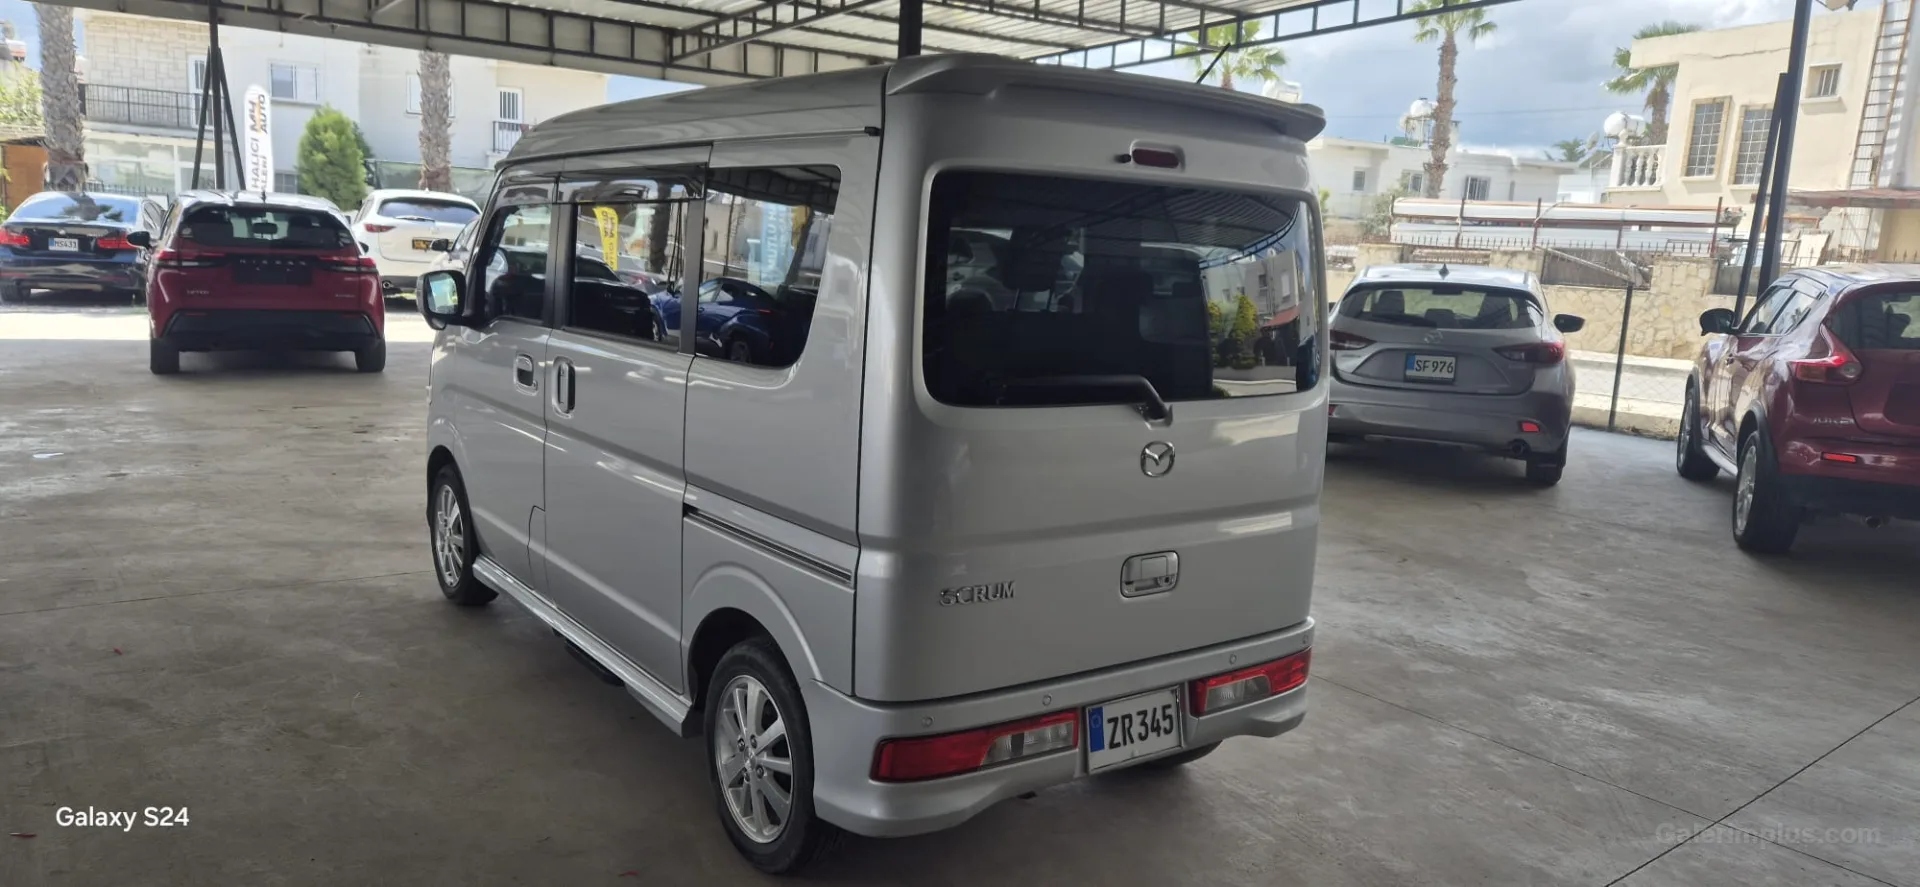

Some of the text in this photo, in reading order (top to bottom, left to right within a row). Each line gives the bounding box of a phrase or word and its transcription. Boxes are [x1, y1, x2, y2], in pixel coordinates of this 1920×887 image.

[248, 100, 258, 133] MH
[257, 94, 268, 134] AUTO
[250, 137, 260, 189] HALICI
[766, 223, 778, 270] MUTLU
[939, 580, 1016, 607] SCRUM
[1107, 703, 1174, 749] ZR 345
